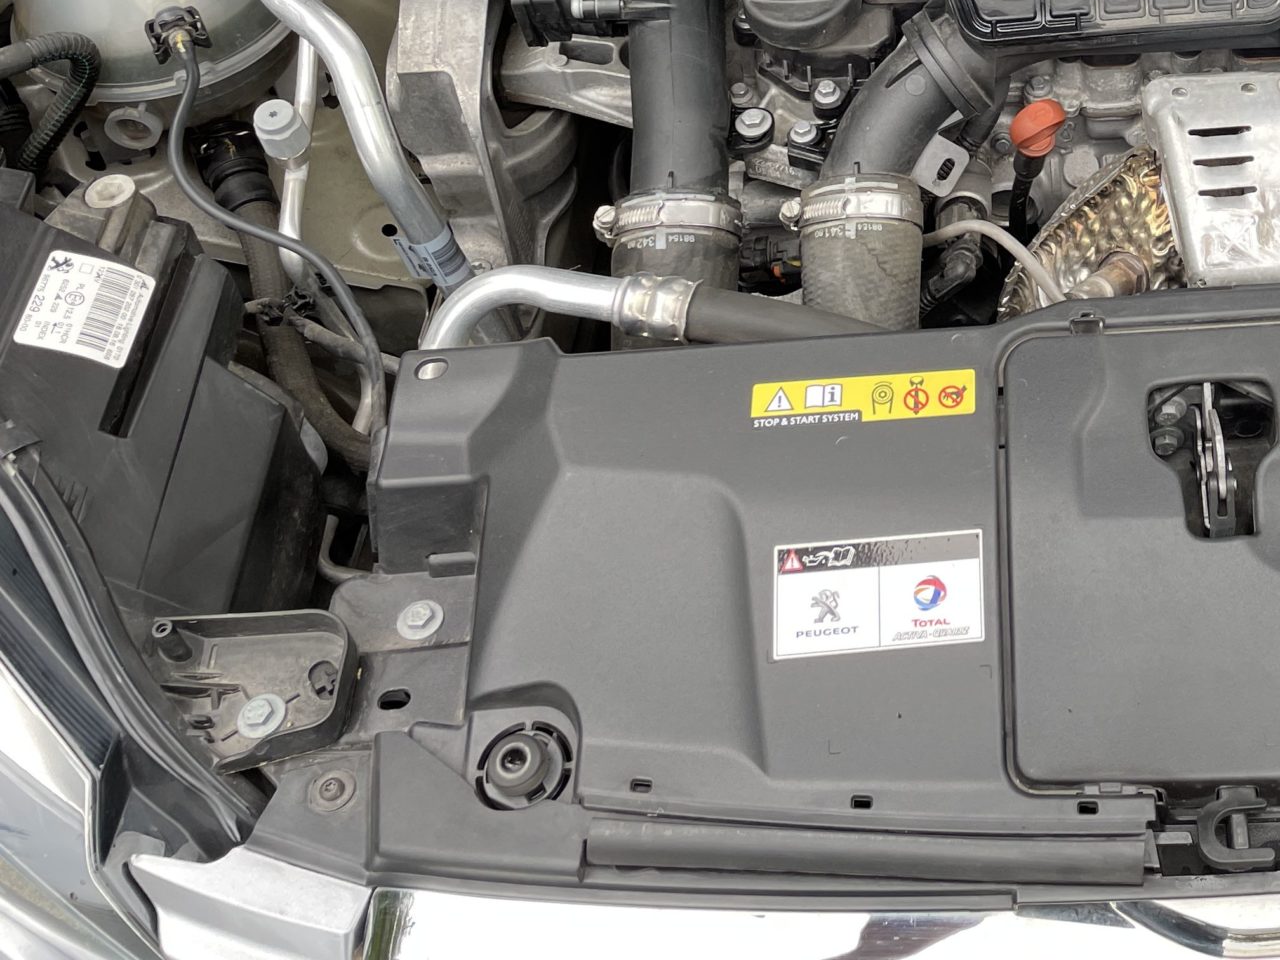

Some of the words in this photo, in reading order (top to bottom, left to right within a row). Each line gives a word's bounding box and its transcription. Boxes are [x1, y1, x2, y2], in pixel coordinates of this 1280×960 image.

[29, 294, 45, 313] 229
[753, 419, 780, 428] STOP
[781, 417, 788, 426] &
[789, 414, 821, 426] START
[822, 412, 859, 423] SYSTEM
[912, 618, 951, 628] TOTAL
[796, 625, 859, 639] PEUGEOT
